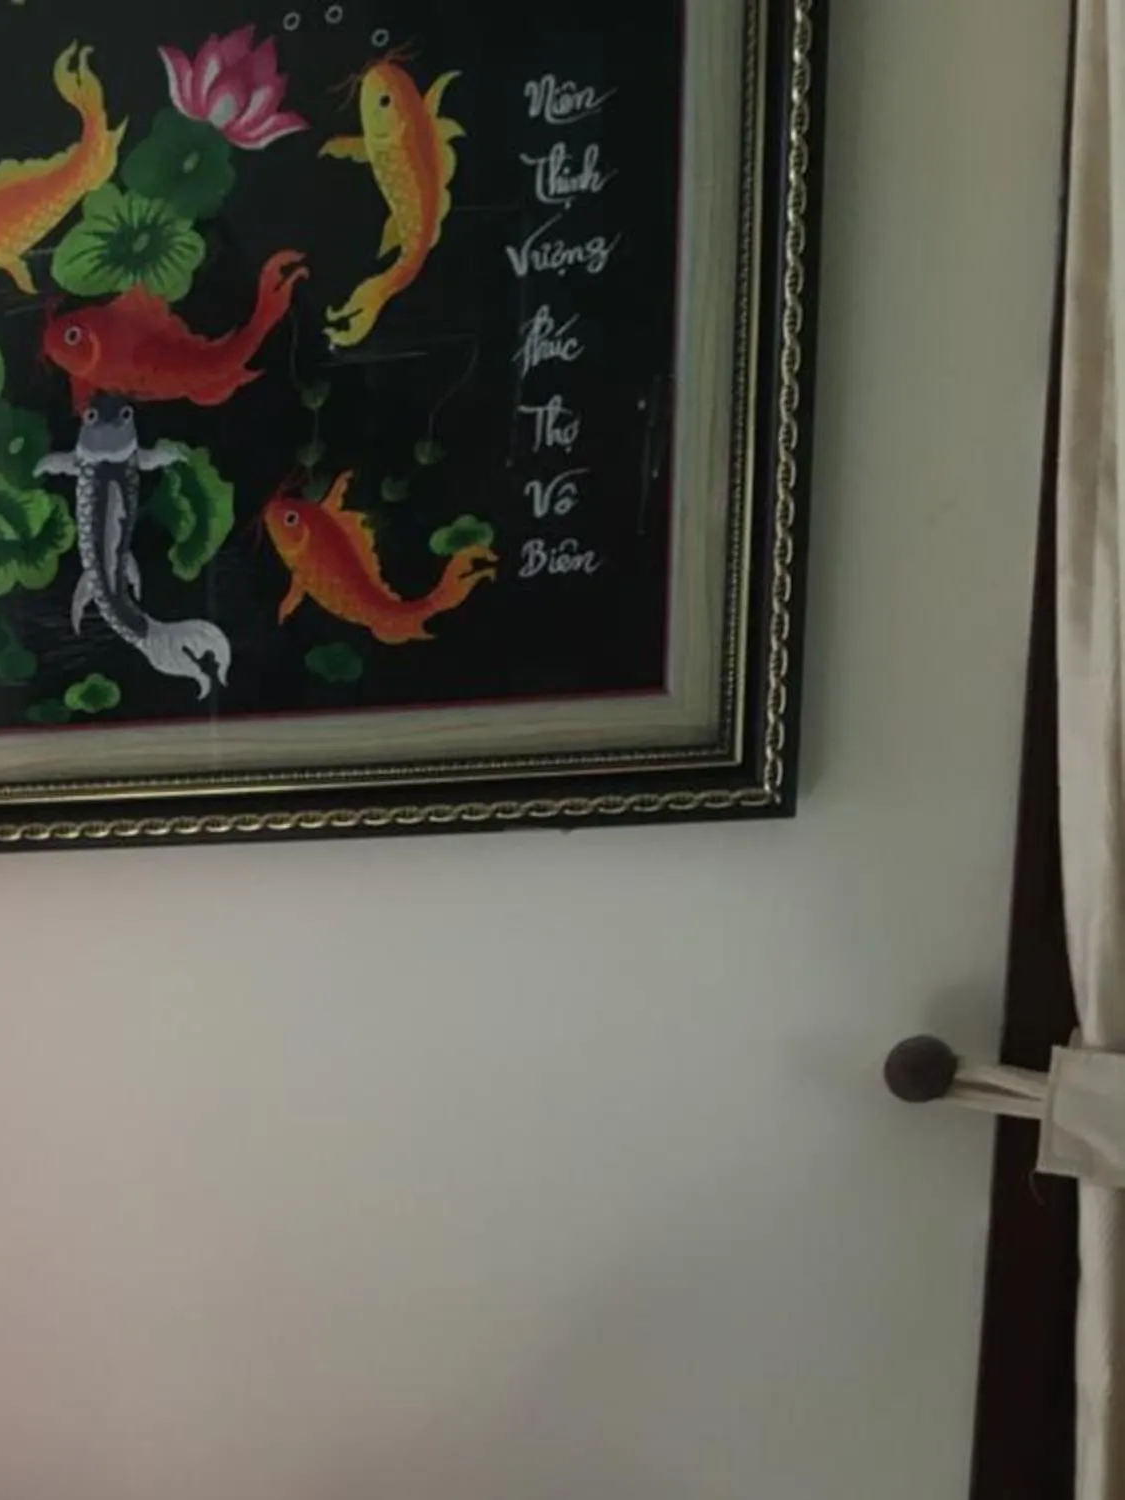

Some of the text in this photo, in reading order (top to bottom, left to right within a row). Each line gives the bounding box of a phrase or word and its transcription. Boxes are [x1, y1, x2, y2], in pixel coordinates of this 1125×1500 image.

[524, 73, 619, 124] Niên
[524, 468, 591, 518] Vô
[519, 537, 603, 577] Biên
